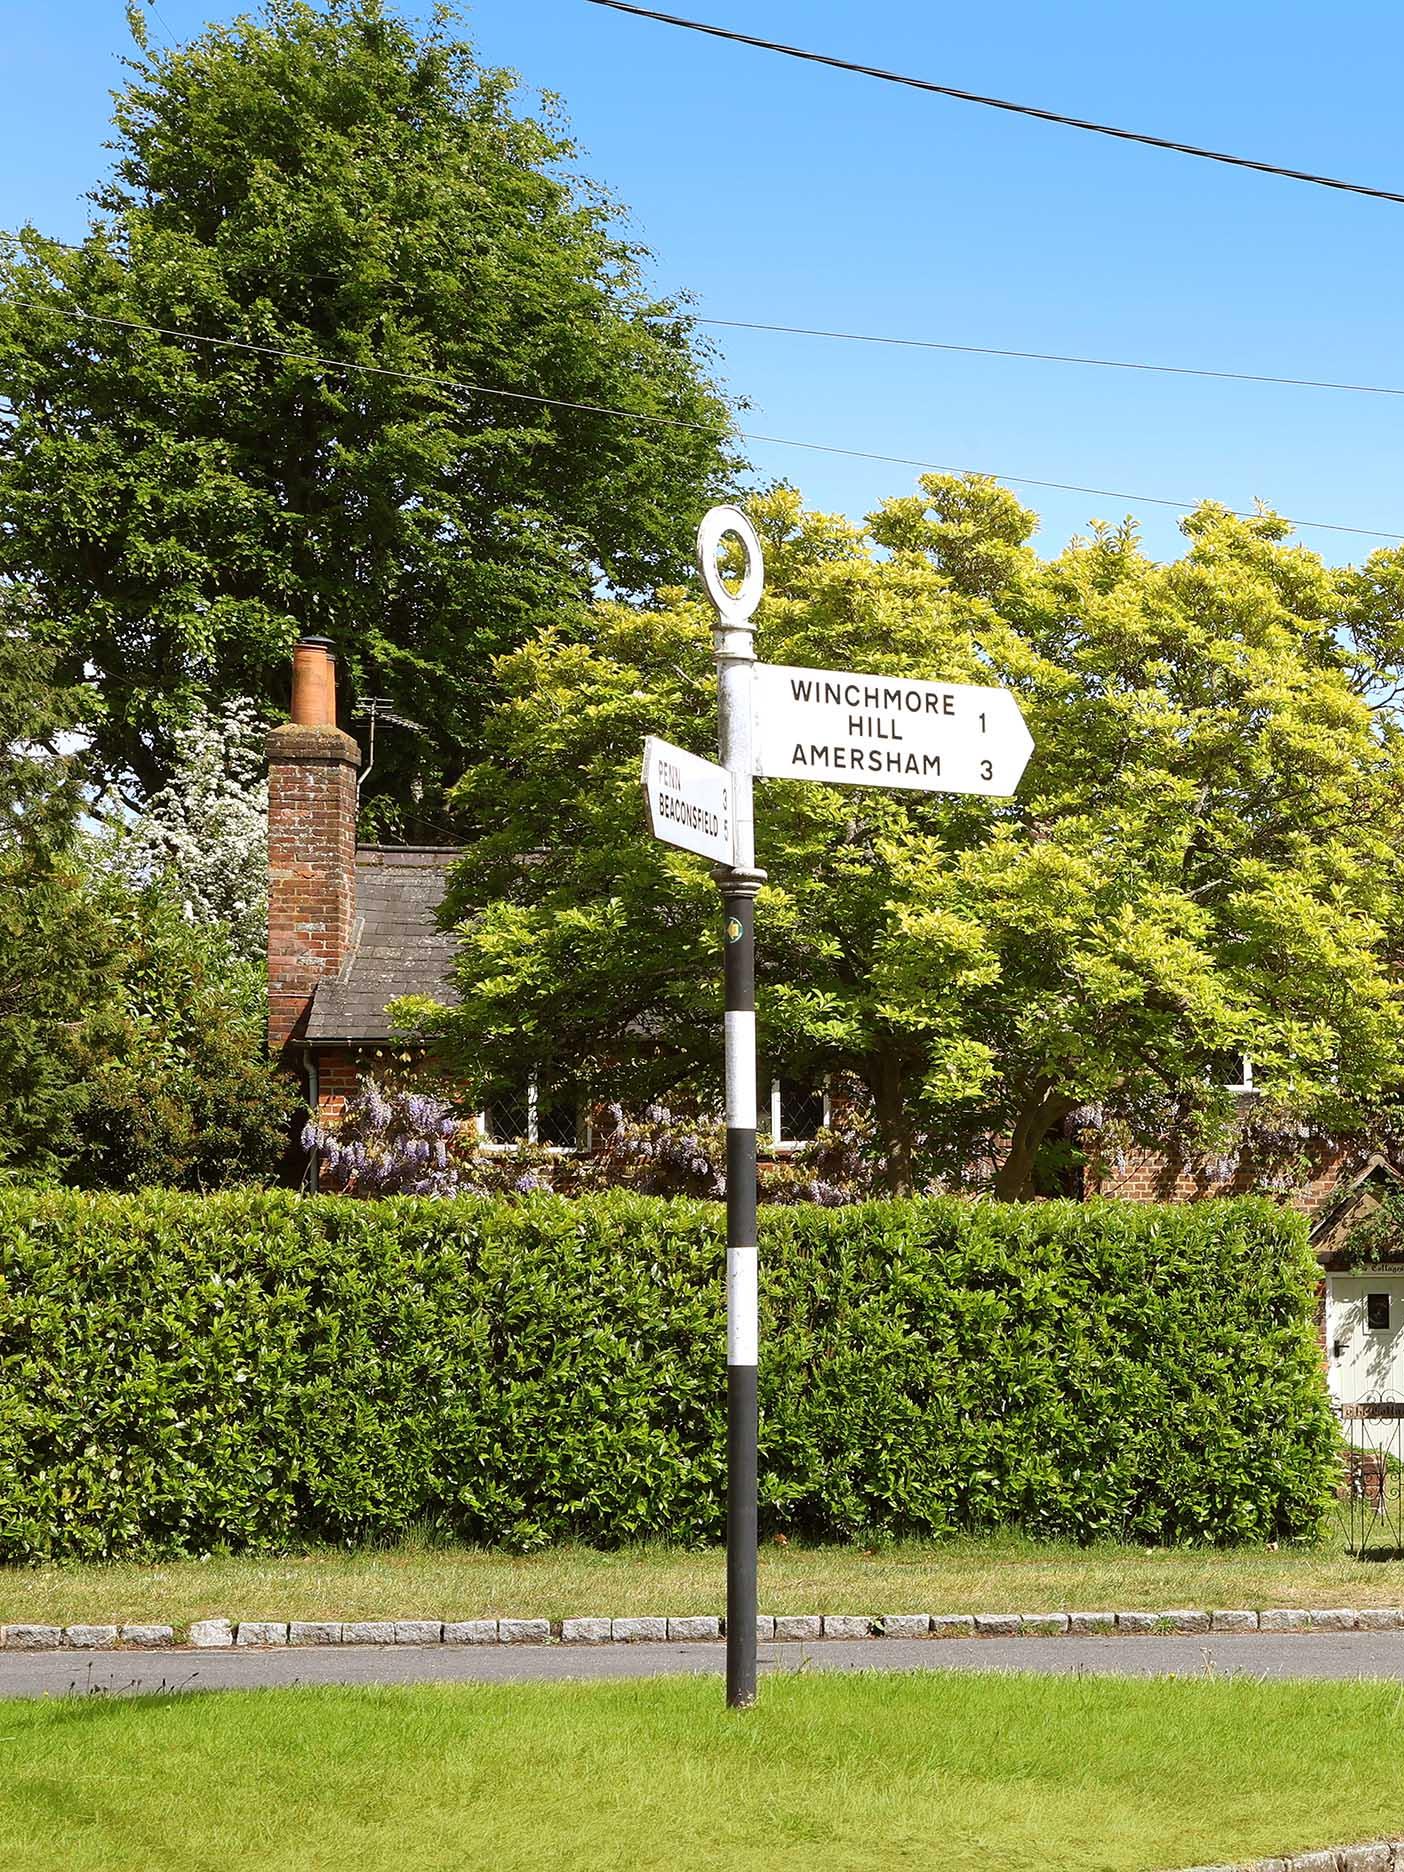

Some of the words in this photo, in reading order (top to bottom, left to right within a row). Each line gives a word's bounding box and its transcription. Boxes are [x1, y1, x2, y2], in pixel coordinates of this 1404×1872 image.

[791, 679, 956, 717] WINCHMORE
[847, 714, 904, 742] HILL
[978, 711, 988, 735] 1
[791, 743, 942, 778] AMERSHAM
[980, 759, 994, 782] 3
[658, 760, 681, 791] PENN
[722, 788, 728, 811] 3
[659, 792, 719, 837] BEACONSFIELD
